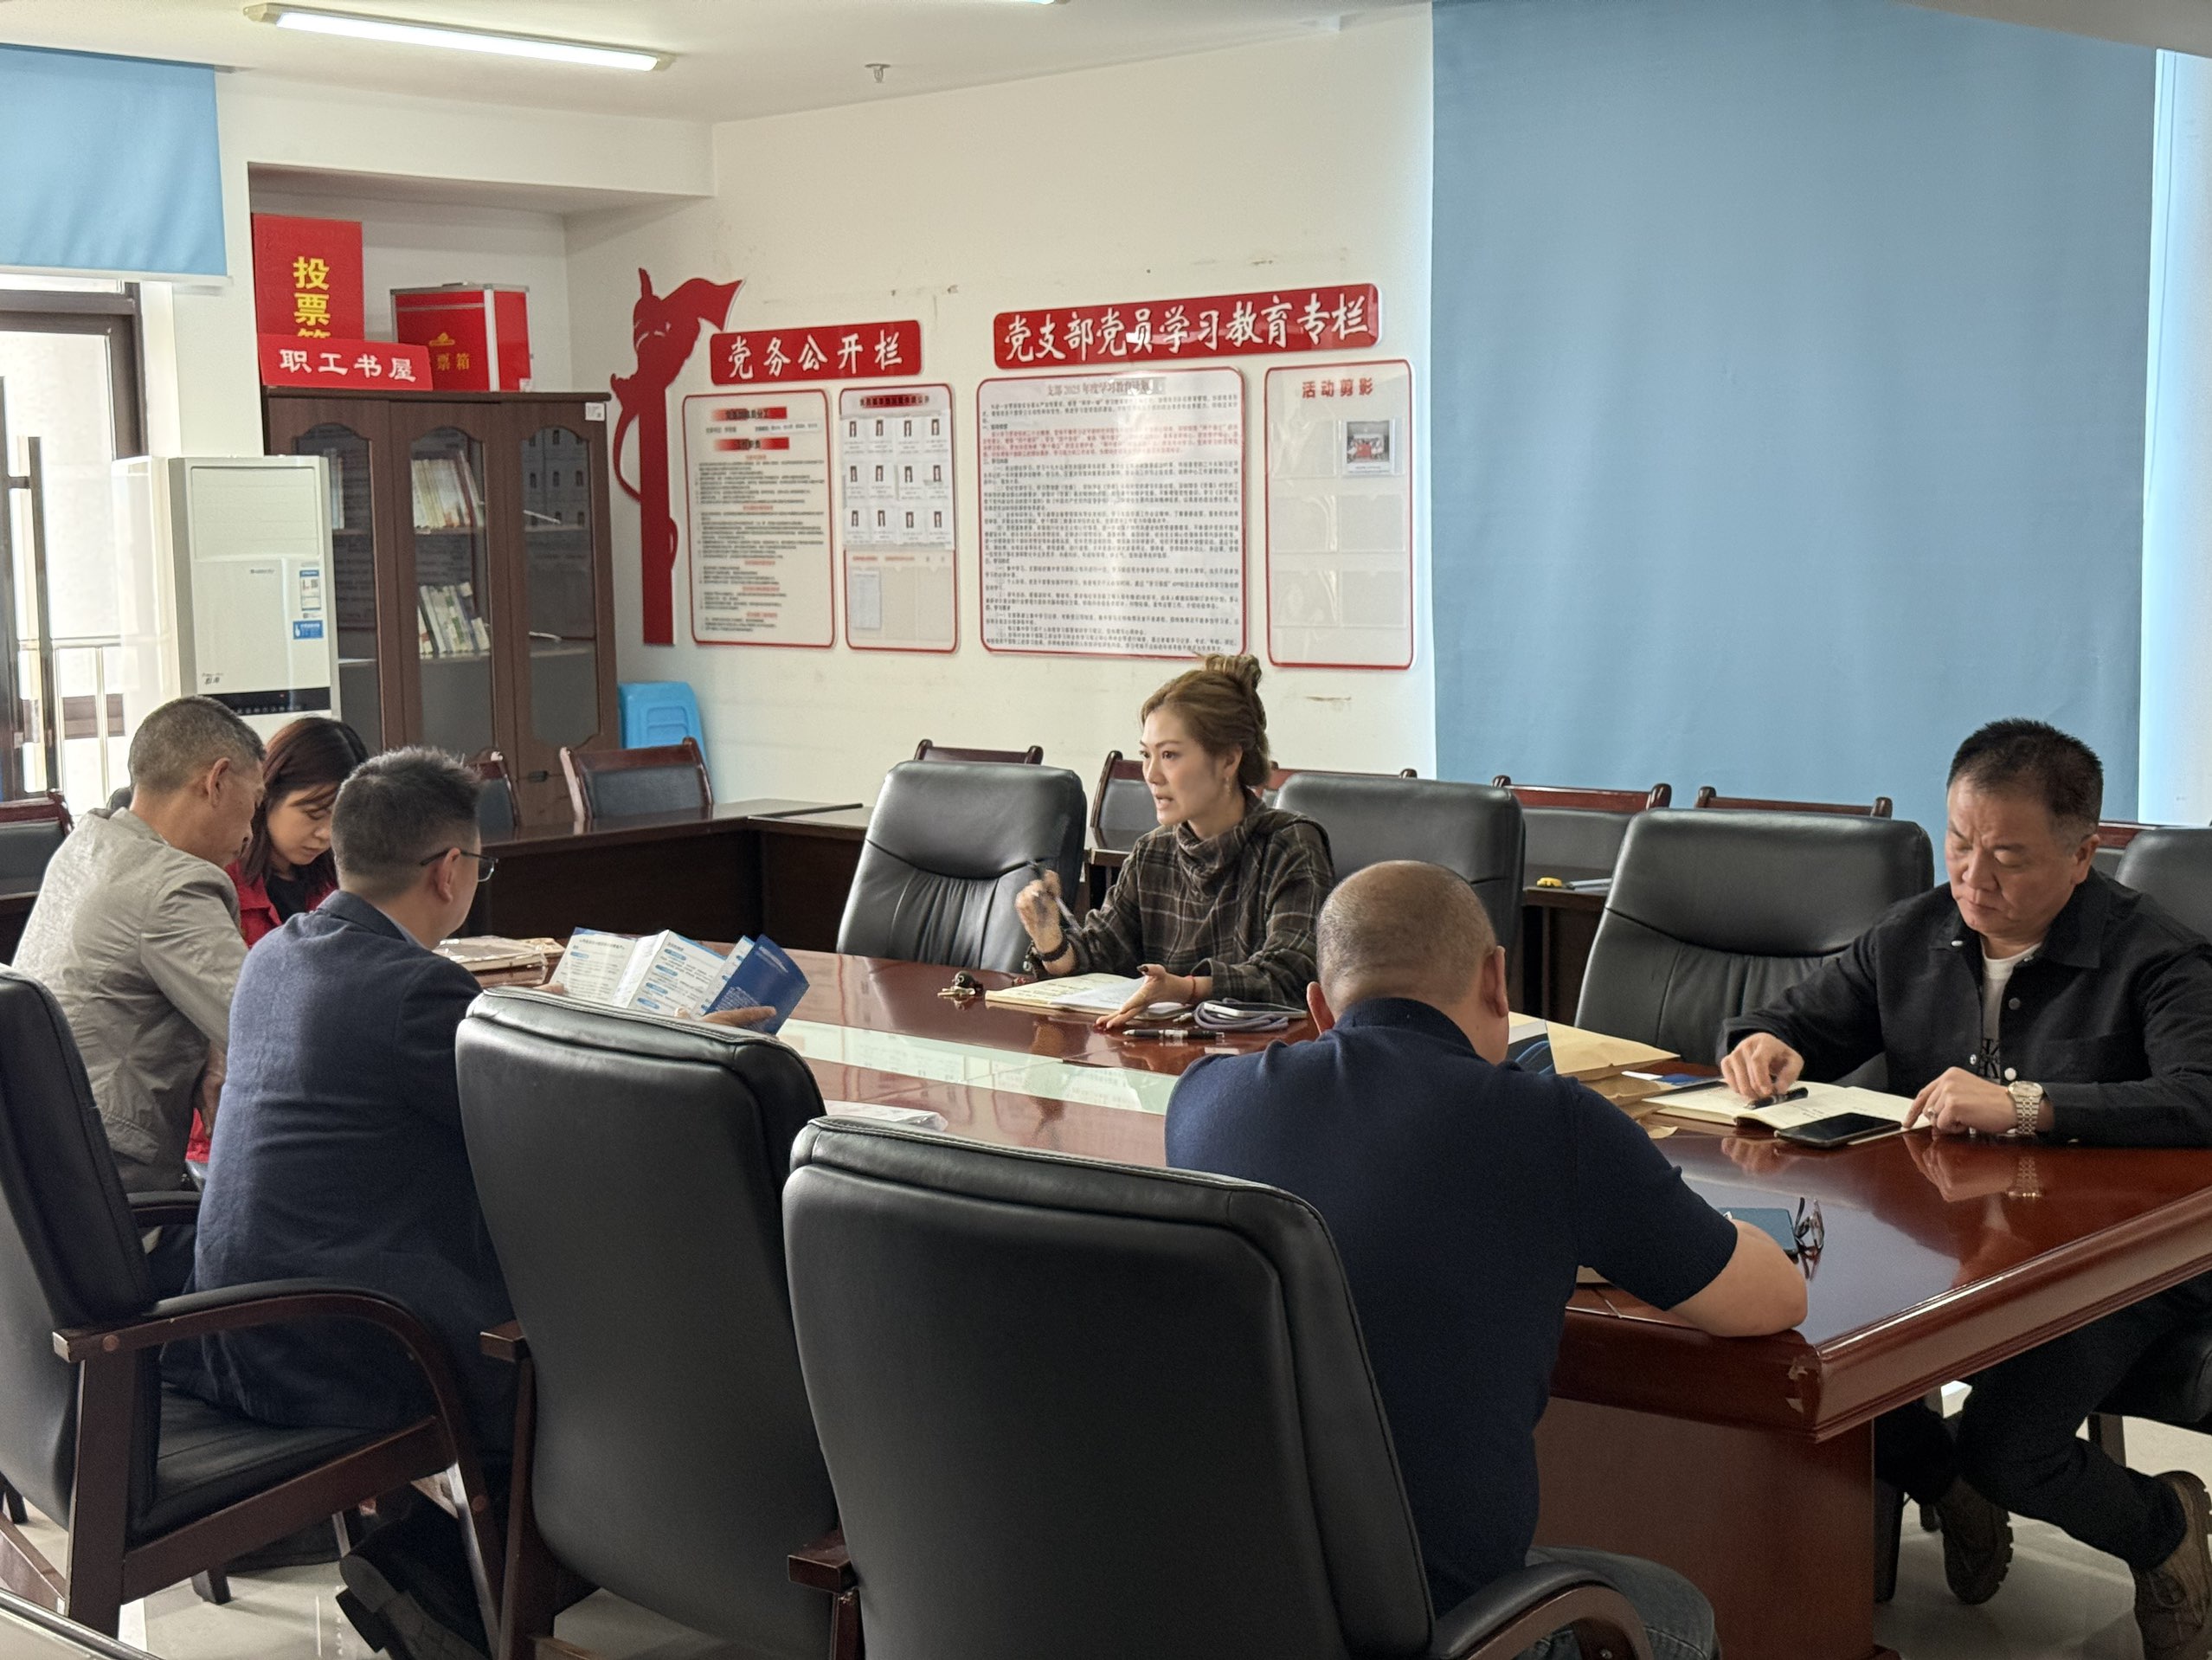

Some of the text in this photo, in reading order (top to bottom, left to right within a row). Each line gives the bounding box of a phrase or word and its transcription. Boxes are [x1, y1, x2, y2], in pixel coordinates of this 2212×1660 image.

[1004, 293, 1369, 363] 党支部党员学习教育专栏
[279, 349, 416, 383] 职工书屋
[436, 352, 471, 371] 票箱
[728, 329, 903, 379] 党务公开栏
[1302, 376, 1374, 399] 活动剪影
